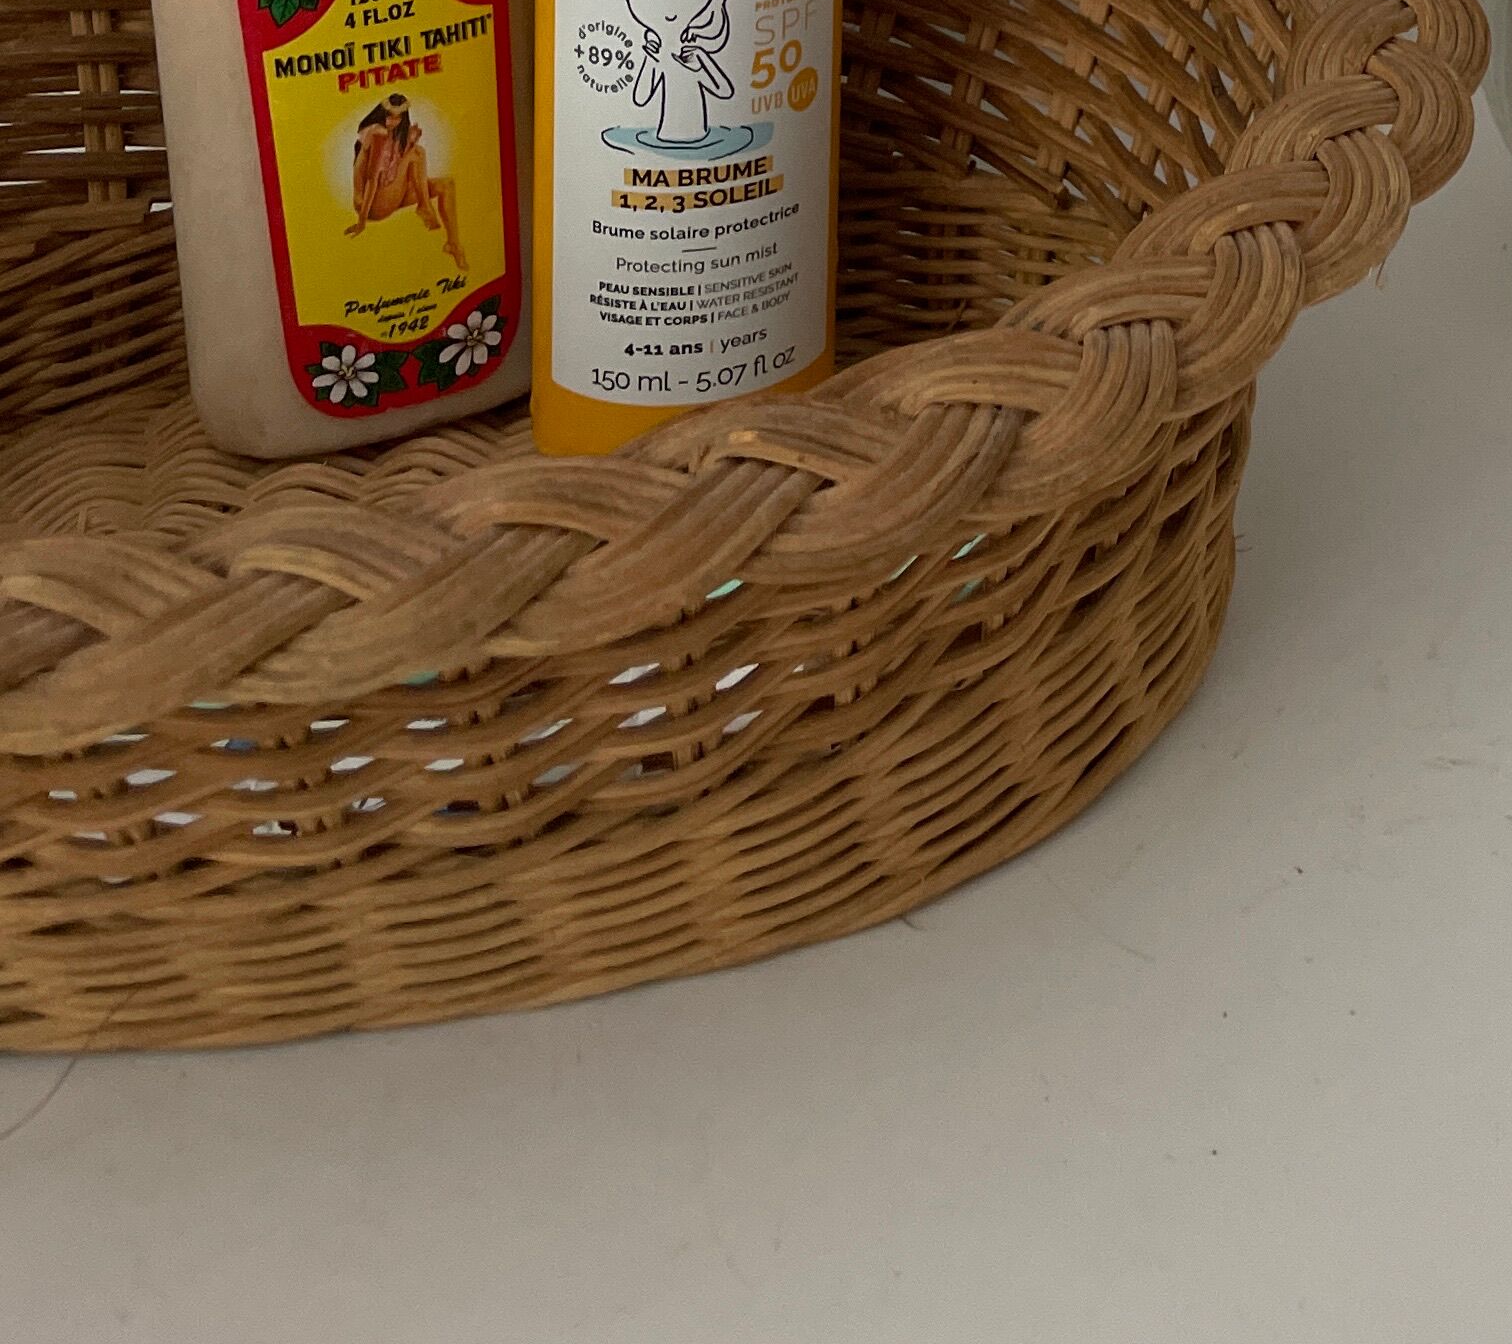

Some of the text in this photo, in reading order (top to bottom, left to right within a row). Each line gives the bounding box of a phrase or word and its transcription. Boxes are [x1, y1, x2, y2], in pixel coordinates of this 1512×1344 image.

[344, 0, 416, 29] 4 FL.OZ
[578, 19, 633, 48] d'origine
[274, 41, 356, 79] MONOÏ
[363, 34, 411, 64] TIKI
[337, 53, 443, 93] PITATE
[750, 39, 803, 89] 50
[577, 64, 634, 94] naturelle
[751, 78, 816, 115] UVB UVA
[632, 156, 768, 188] MA BRUME
[672, 195, 685, 214] 3
[693, 179, 777, 209] SOLEIL
[592, 202, 799, 241] Brume solaire protectrice
[616, 242, 778, 275] Protecting sun mist
[589, 272, 799, 311] RÉSISTE À L'EAU WATER RESISTANT
[599, 261, 792, 297] PEAU SENSIBLE SENSITIVE SKIN
[344, 288, 431, 318] Parfumerie
[599, 310, 643, 325] VISAGE
[645, 316, 661, 326] ET
[663, 314, 708, 325] CORPS
[718, 306, 748, 320] FACE
[761, 291, 791, 310] BODY
[388, 315, 430, 338] 1942
[624, 328, 767, 356] 4-11 ans years
[591, 368, 630, 391] 150
[638, 371, 671, 391] ml
[696, 363, 747, 392] 5.07
[754, 355, 766, 377] fl
[773, 345, 797, 369] oz
